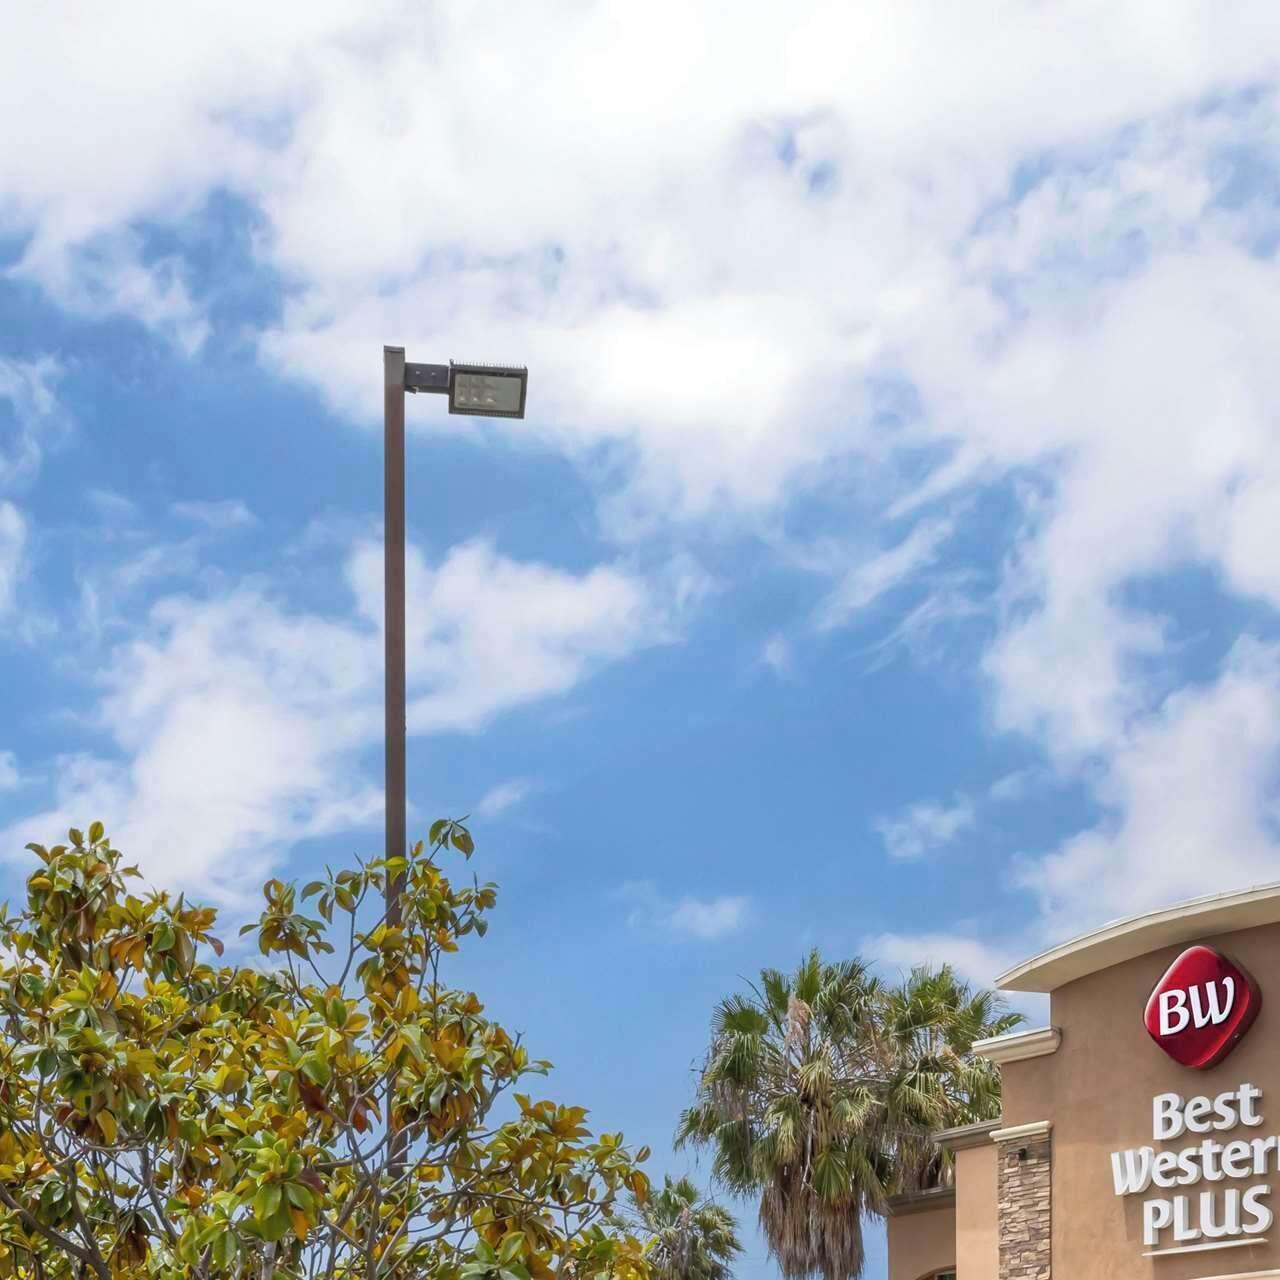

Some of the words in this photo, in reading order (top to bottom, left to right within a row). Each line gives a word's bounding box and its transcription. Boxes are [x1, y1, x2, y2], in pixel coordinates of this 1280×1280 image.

[1158, 976, 1235, 1036] BW
[1152, 1083, 1264, 1141] Best
[1142, 1184, 1273, 1245] PLUS
